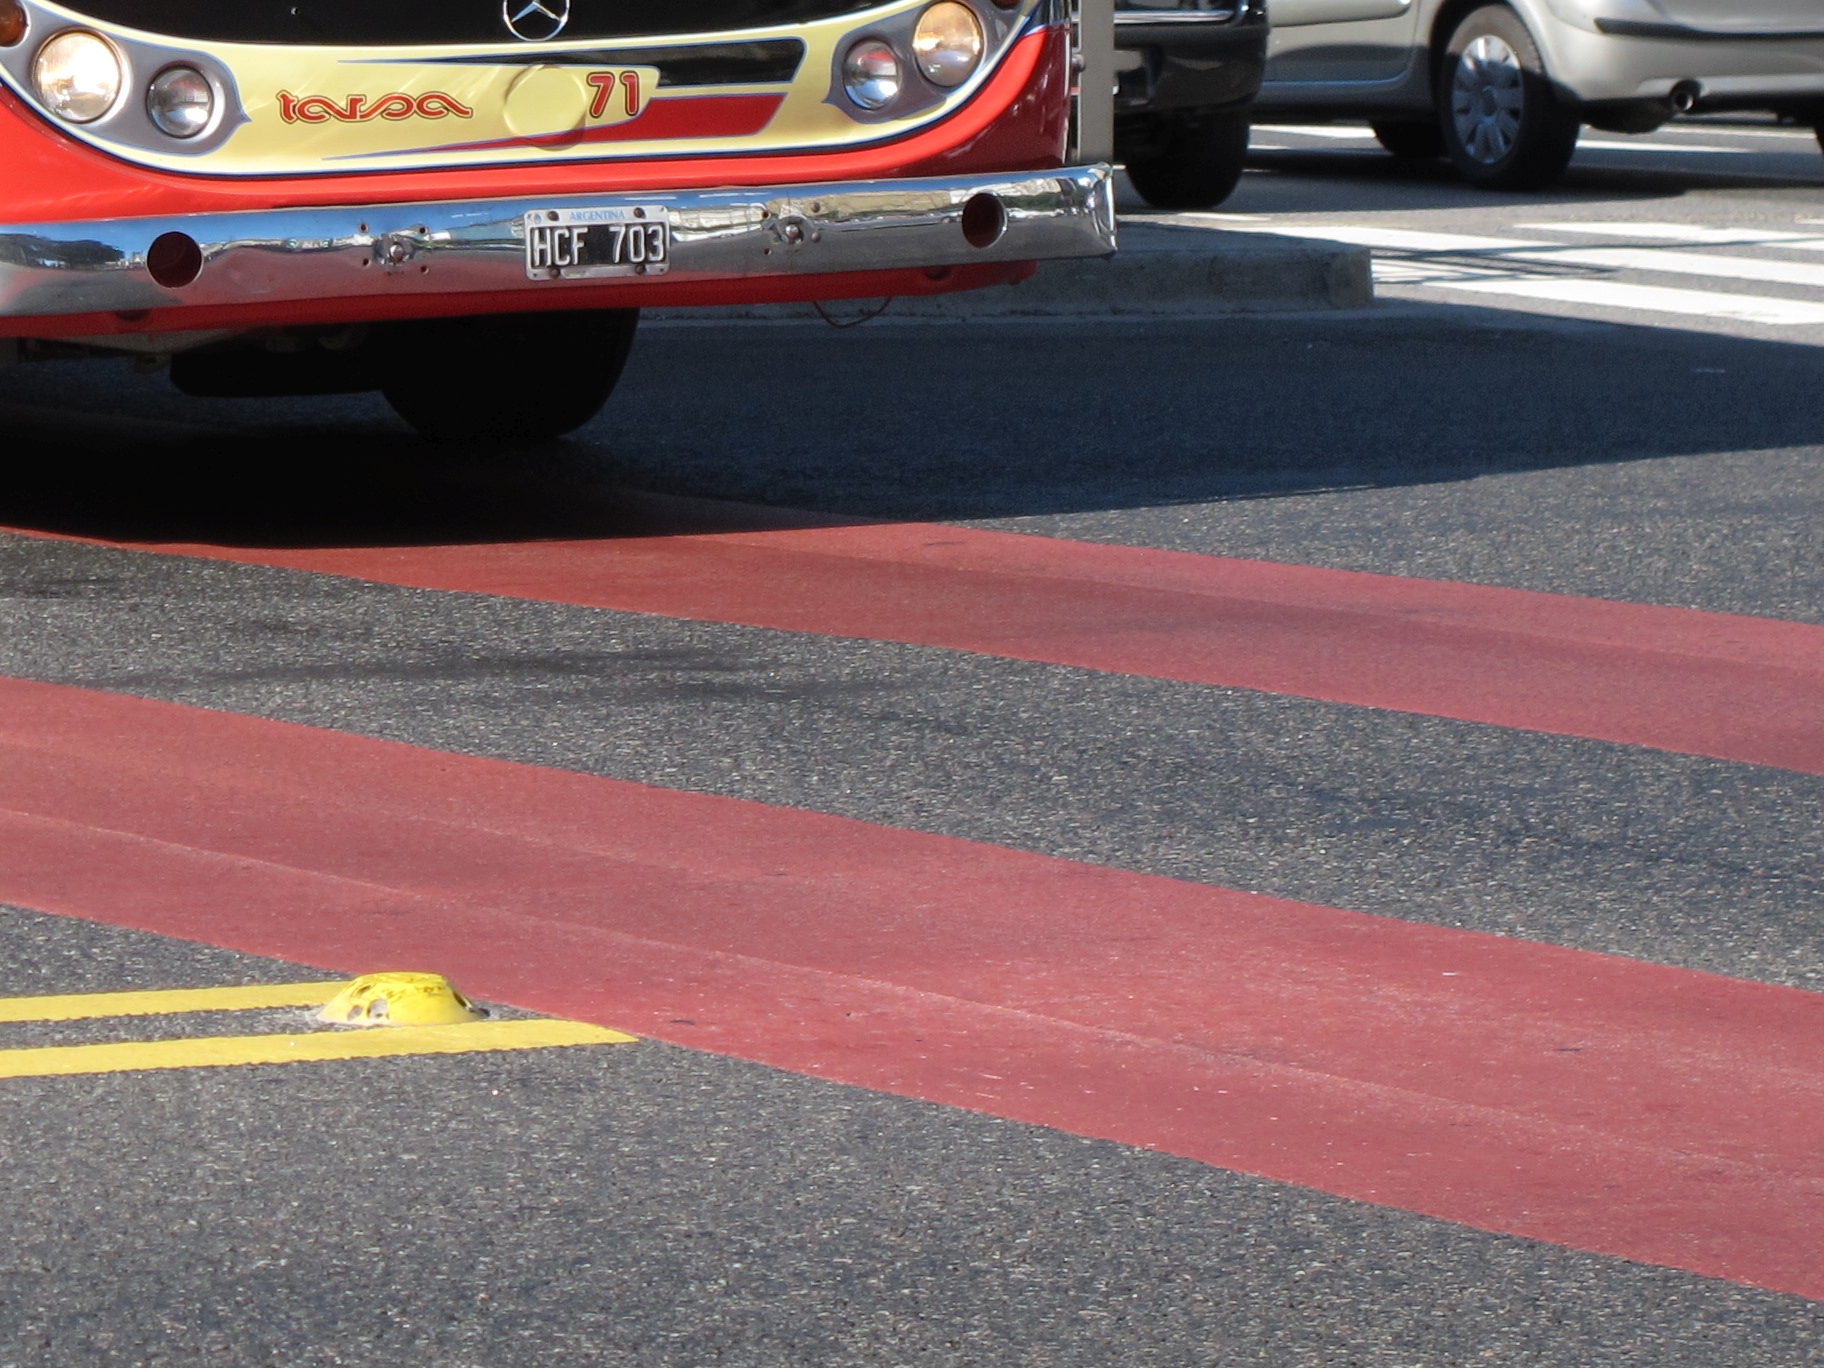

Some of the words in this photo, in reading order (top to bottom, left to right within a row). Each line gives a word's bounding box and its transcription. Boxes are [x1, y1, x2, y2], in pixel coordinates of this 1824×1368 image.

[586, 71, 640, 118] 71
[569, 210, 626, 222] ARGENTINA
[533, 226, 589, 267] HCF
[608, 224, 665, 264] 703
